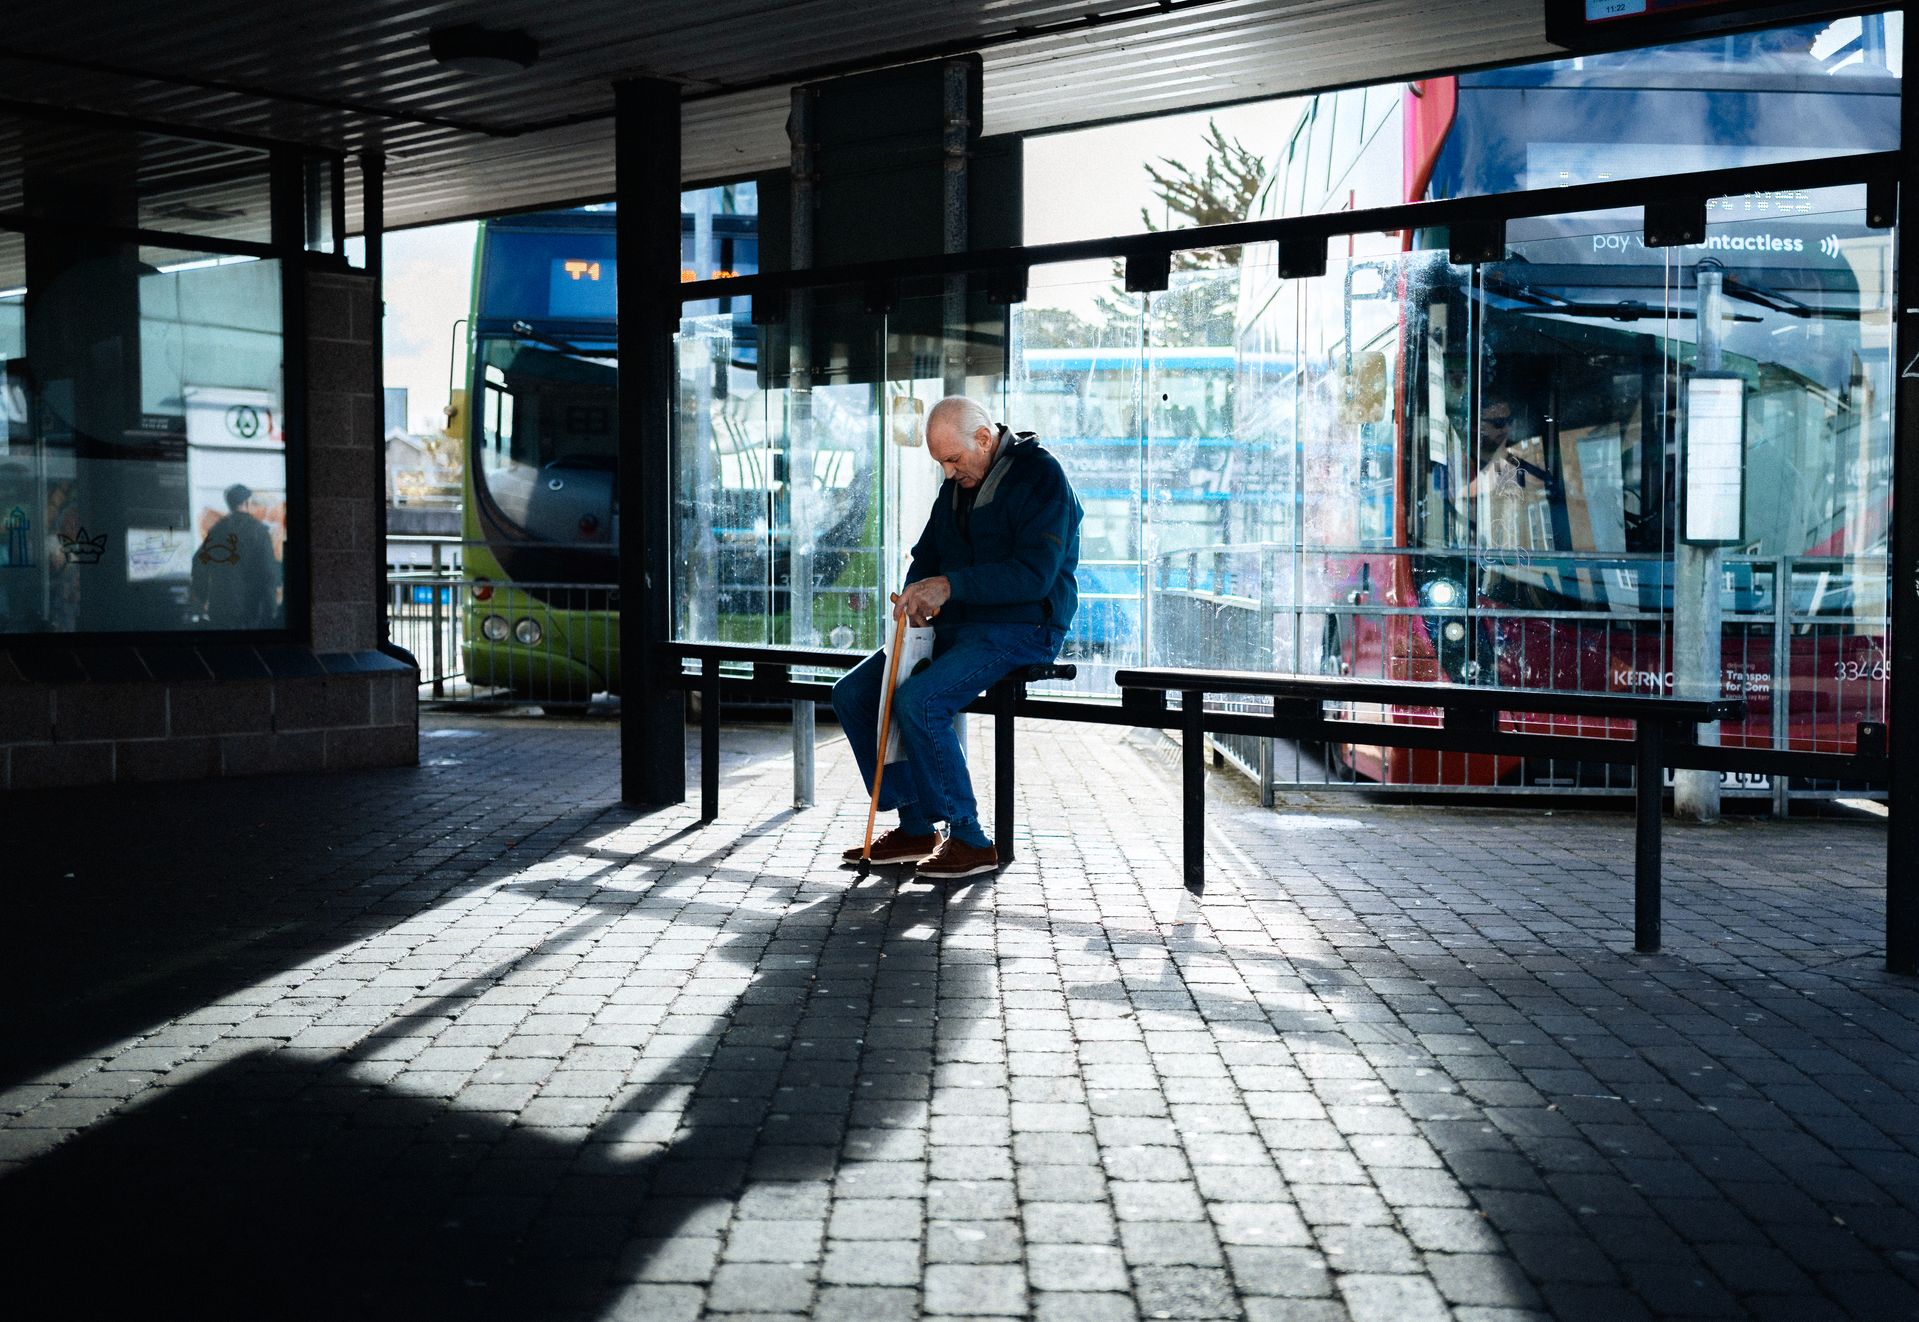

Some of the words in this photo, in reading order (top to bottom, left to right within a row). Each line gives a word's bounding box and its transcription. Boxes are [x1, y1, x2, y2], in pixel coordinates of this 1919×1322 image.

[1606, 3, 1626, 13] 11:22
[1593, 234, 1630, 252] pay
[1726, 670, 1771, 683] Transpo
[1726, 681, 1742, 691] for
